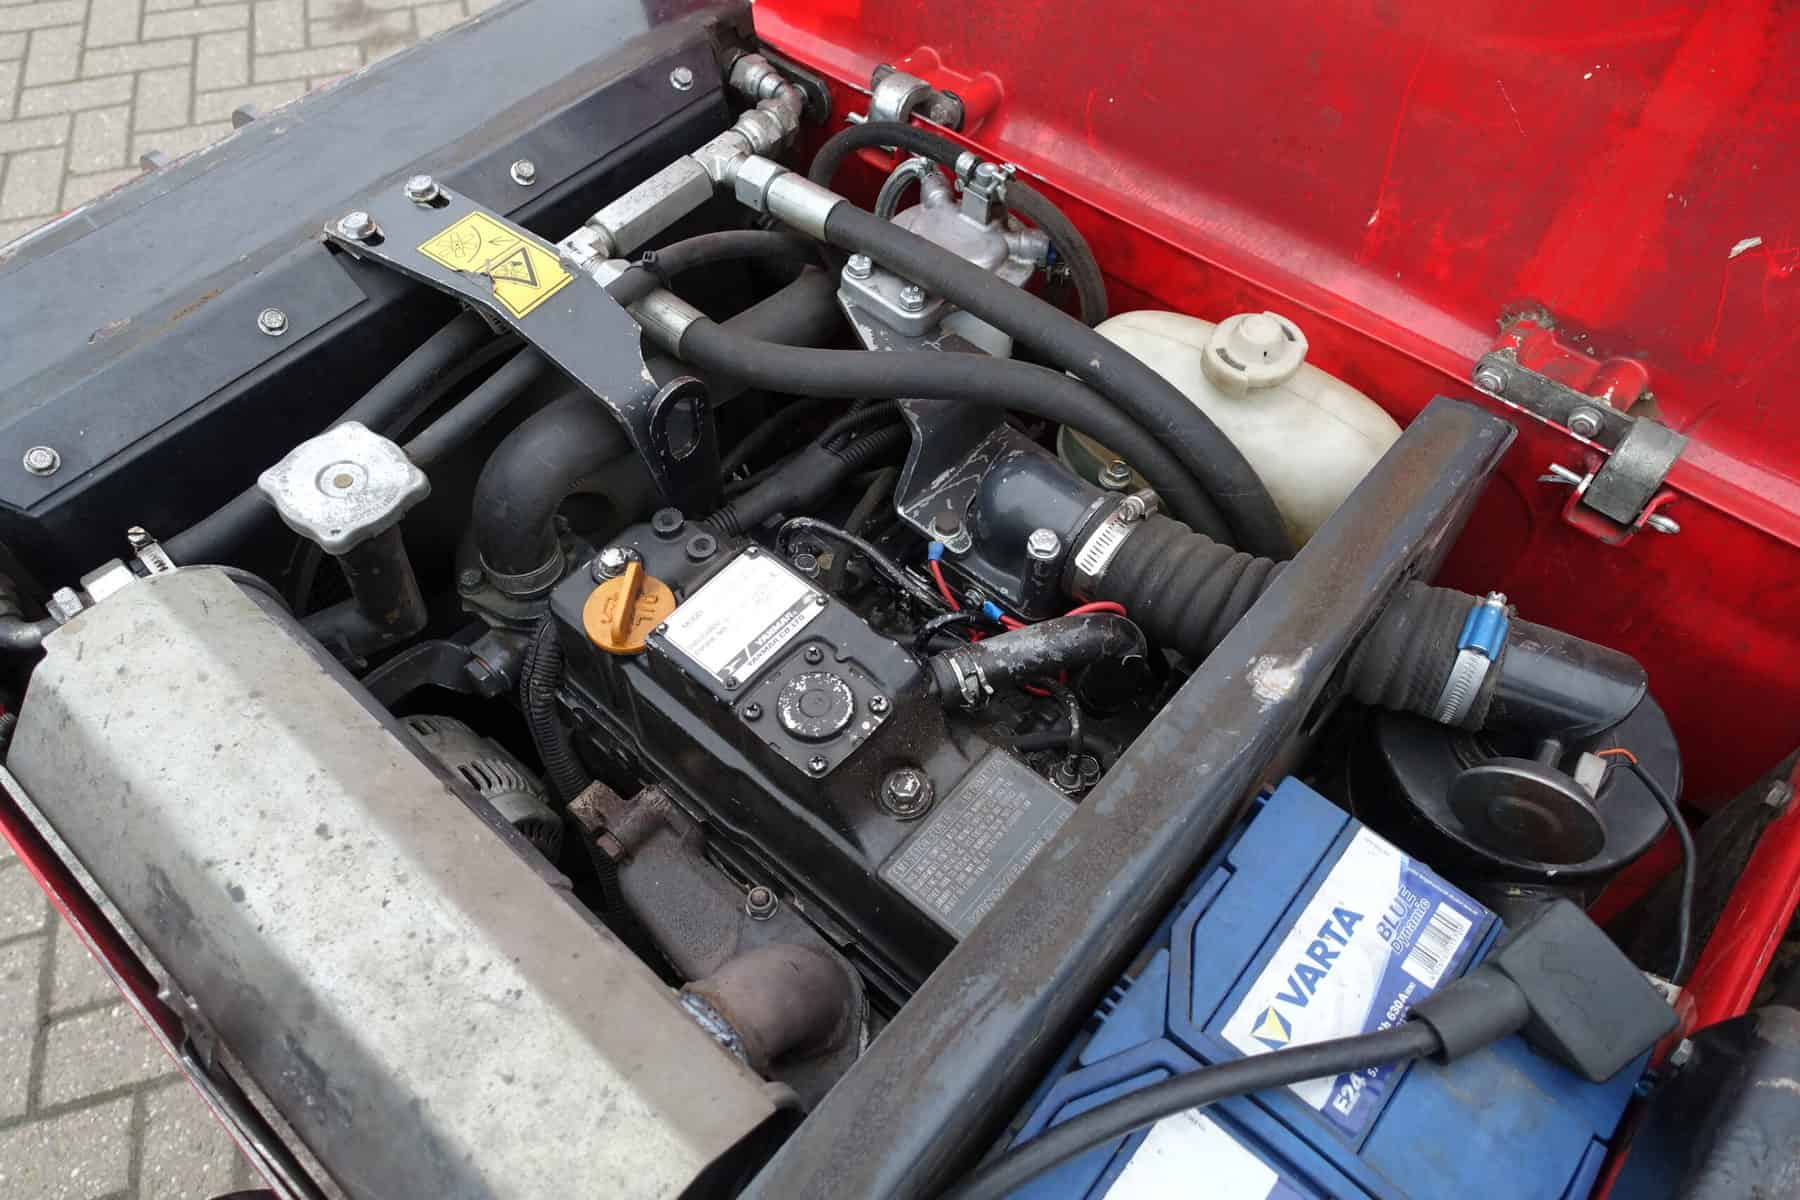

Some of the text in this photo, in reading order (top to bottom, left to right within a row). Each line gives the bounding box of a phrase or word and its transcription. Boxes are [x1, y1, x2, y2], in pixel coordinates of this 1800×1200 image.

[635, 594, 660, 626] OIL
[755, 608, 799, 647] YANMAR
[1376, 884, 1418, 942] BLUE
[1276, 906, 1365, 1008] VARTA
[1332, 1072, 1367, 1117] E24
